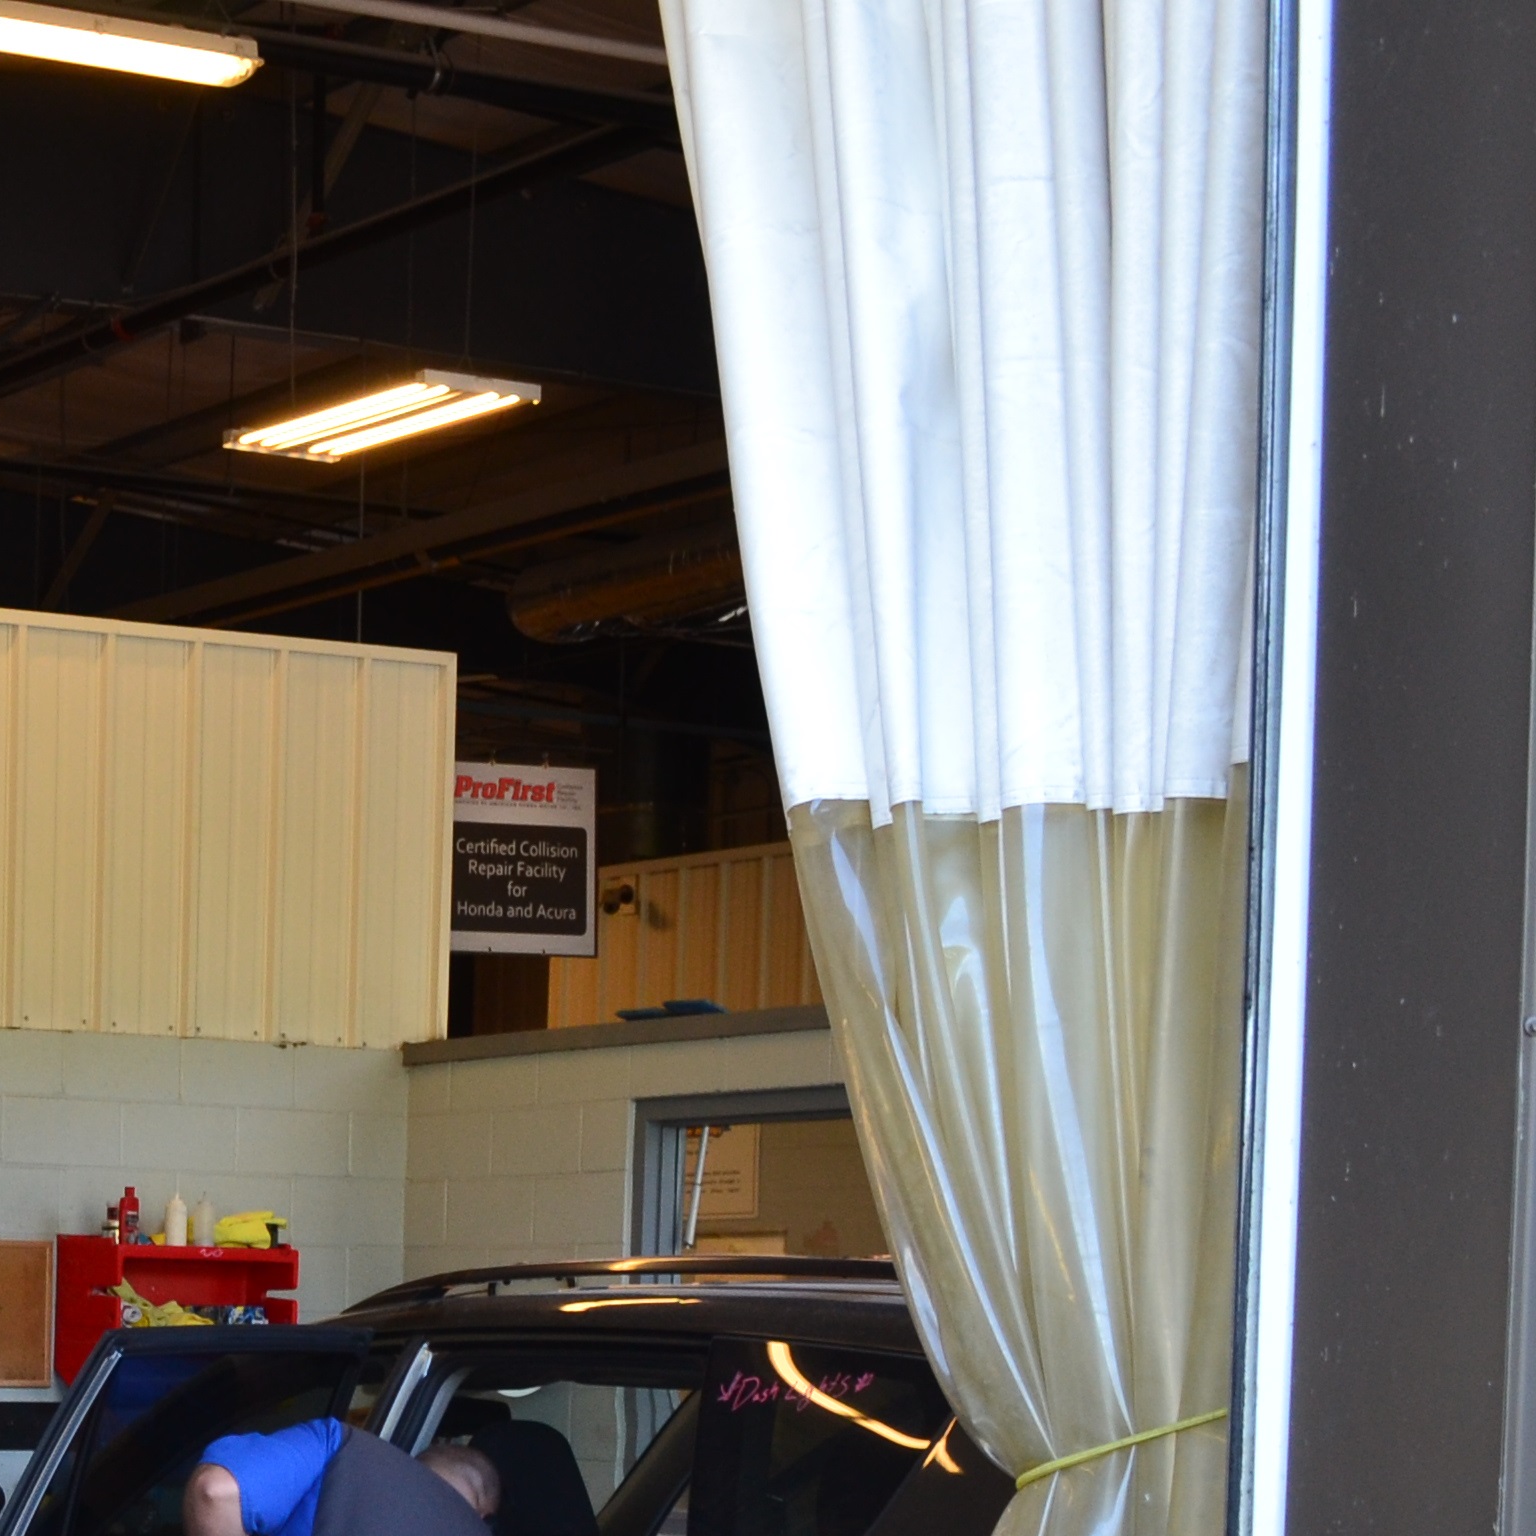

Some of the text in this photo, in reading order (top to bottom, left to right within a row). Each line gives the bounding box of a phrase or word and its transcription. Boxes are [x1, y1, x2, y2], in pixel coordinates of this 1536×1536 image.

[454, 775, 556, 802] ProFirst
[456, 838, 578, 859] Certified Collision
[468, 859, 566, 882] Repair Facility
[507, 881, 527, 897] for
[457, 901, 577, 920] Honda and Acura
